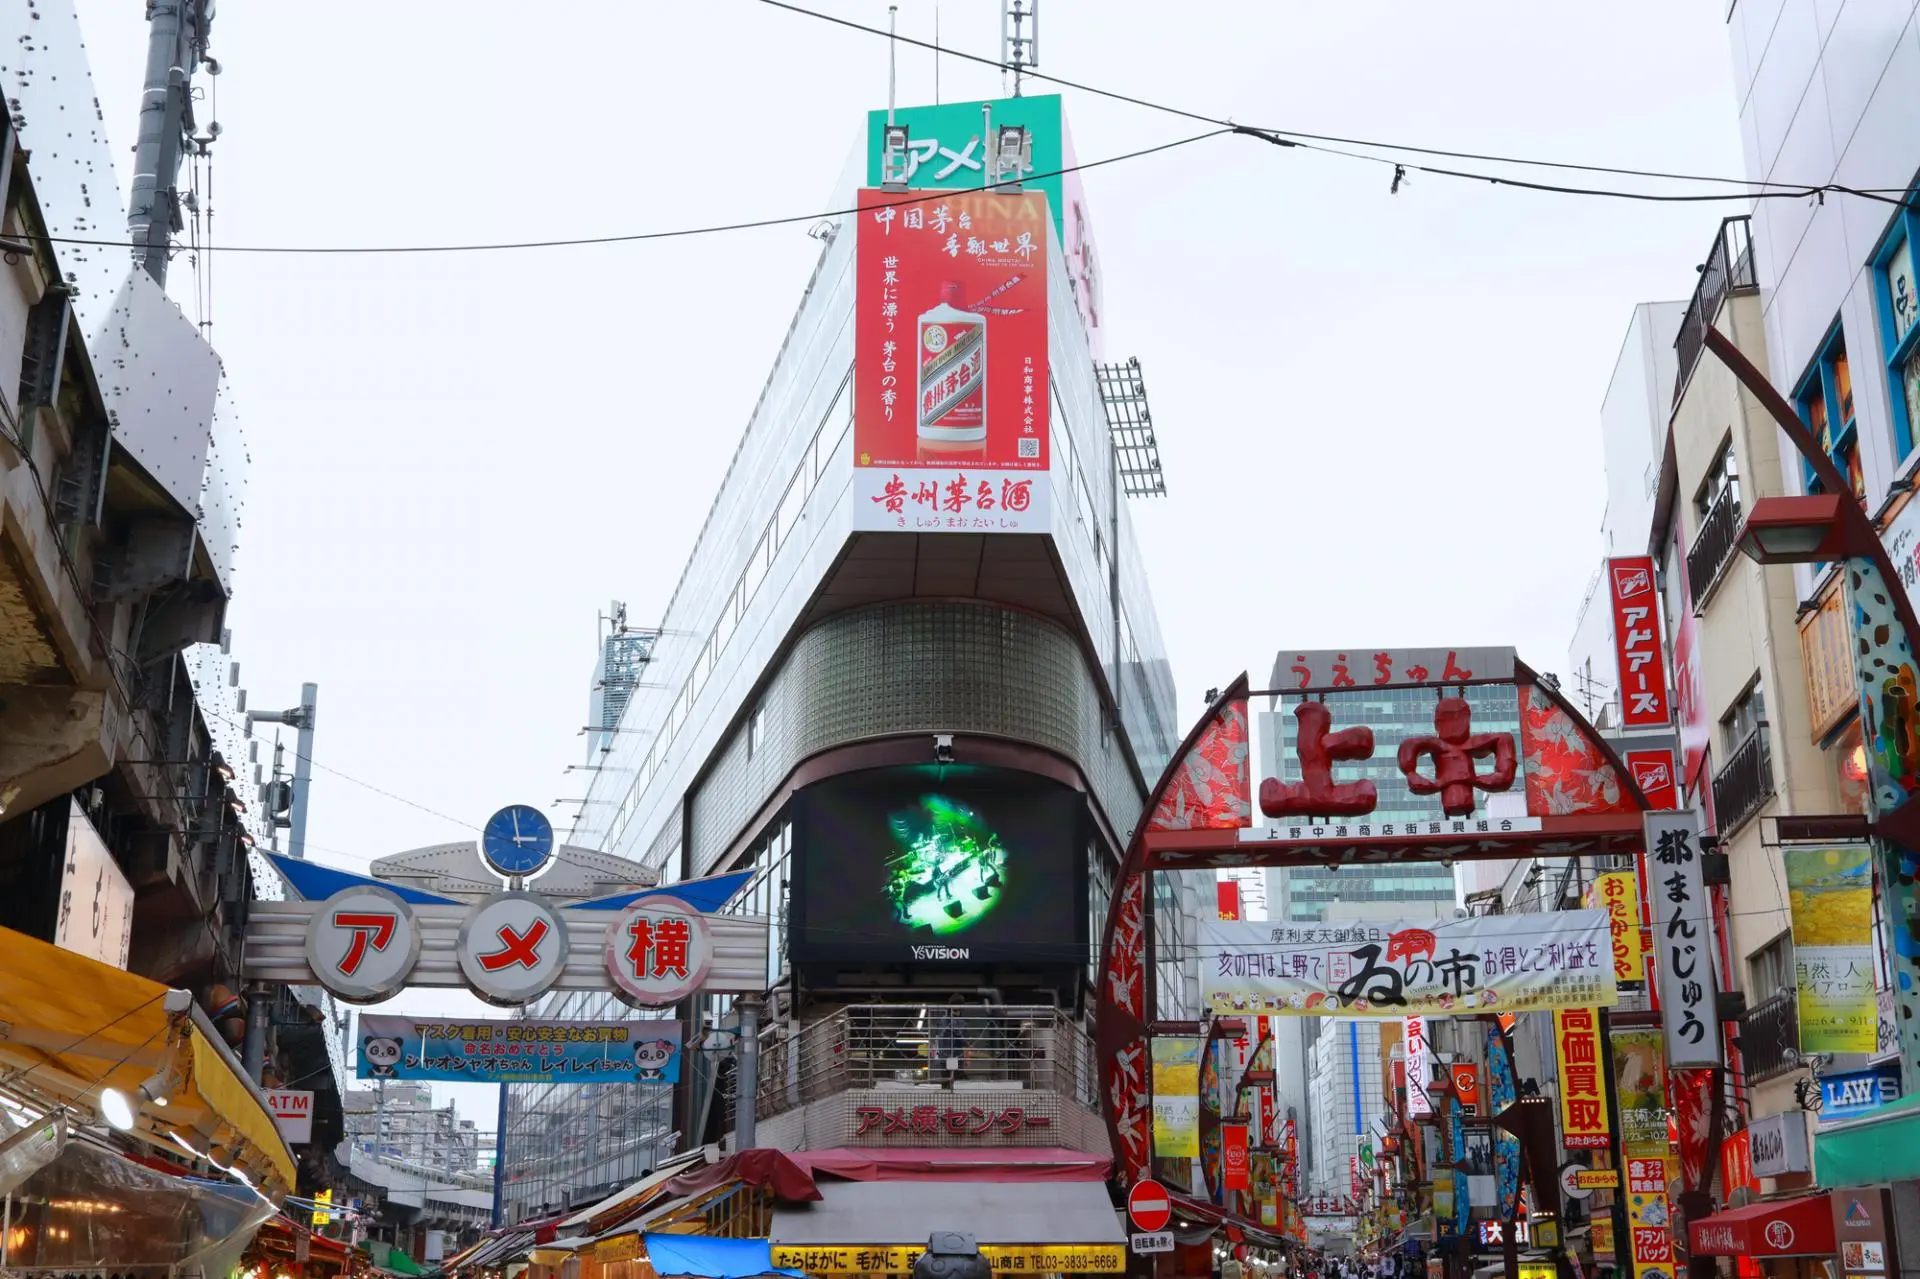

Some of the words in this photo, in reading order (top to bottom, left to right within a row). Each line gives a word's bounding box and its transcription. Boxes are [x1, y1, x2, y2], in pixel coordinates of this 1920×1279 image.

[882, 255, 900, 332] 世界に漂う
[881, 340, 897, 422] 茅台の香り
[871, 473, 1033, 514] 貴州茅台酒
[1290, 651, 1473, 689] うえちゅん
[1621, 606, 1660, 714] アドアーズ
[1259, 697, 1518, 818] 上中
[1266, 819, 1514, 841] 上野中通商店街振興組合
[1604, 877, 1632, 978] おたからや
[1655, 828, 1705, 1045] 都まんじゅう
[334, 911, 691, 982] アメ横
[1484, 942, 1600, 975] お得とご利益を
[1218, 951, 1324, 980] 亥の日は上野で
[1561, 1008, 1603, 1131] 高価買取
[268, 1095, 309, 1111] ATM
[855, 1105, 1051, 1135] アメ横センター
[1565, 1135, 1608, 1146] おたからや
[1579, 1175, 1617, 1184] おたからや
[1629, 1160, 1646, 1177] 金
[1631, 1179, 1665, 1192] 貴金属
[1135, 1236, 1172, 1249] 自転車を除く
[1637, 1246, 1669, 1261] バッグ
[777, 1251, 847, 1270] たらばがに
[856, 1251, 898, 1270] 毛がに
